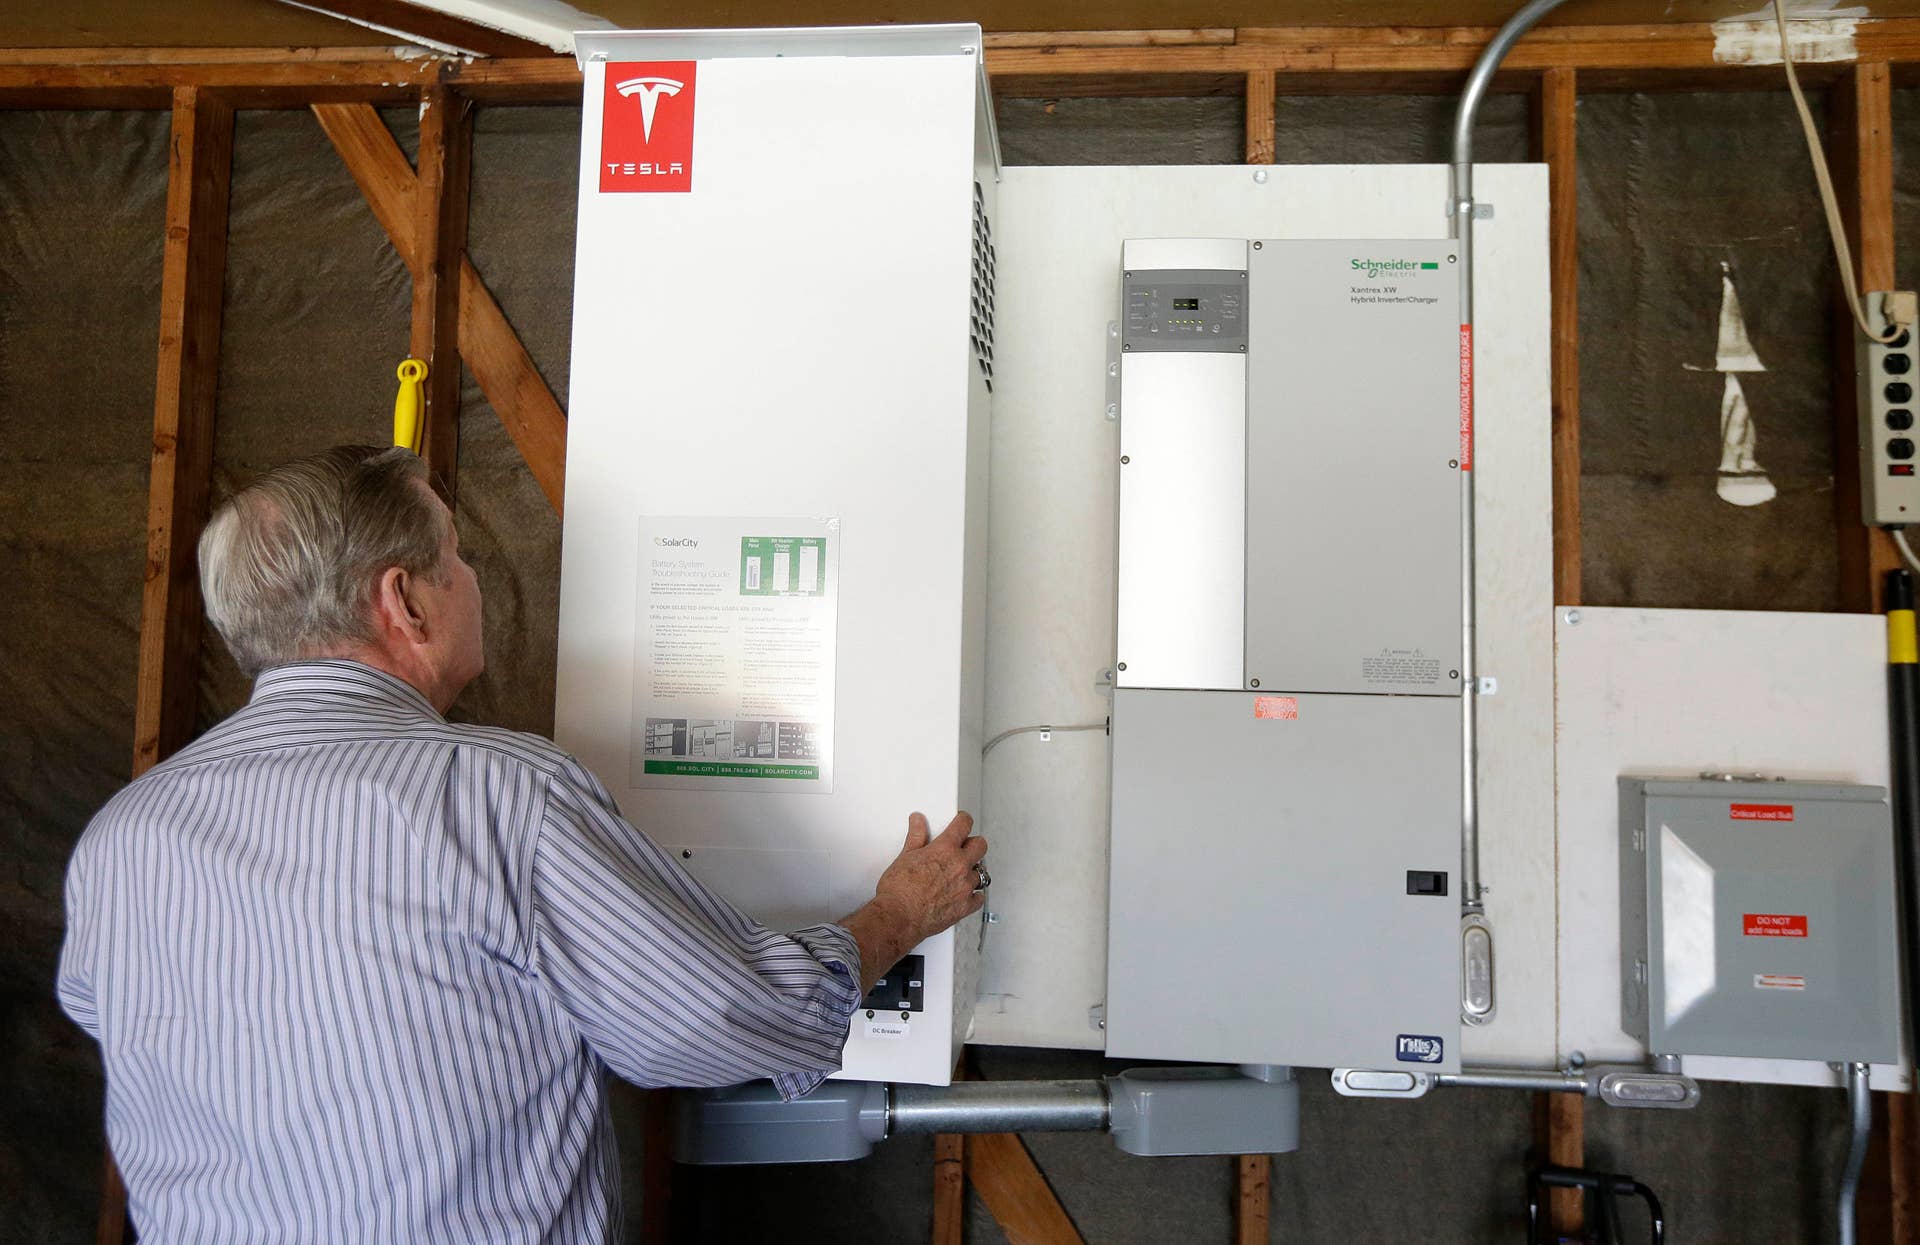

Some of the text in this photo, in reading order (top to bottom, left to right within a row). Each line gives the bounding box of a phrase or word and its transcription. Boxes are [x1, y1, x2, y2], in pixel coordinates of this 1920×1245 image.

[607, 163, 683, 175] TESLA
[1351, 259, 1418, 270] Schneider
[1461, 331, 1470, 357] SOURCE
[1461, 359, 1470, 382] POWER
[662, 538, 698, 548] SolarCity
[652, 569, 705, 578] Troublhooting
[1756, 917, 1791, 925] DO NOT
